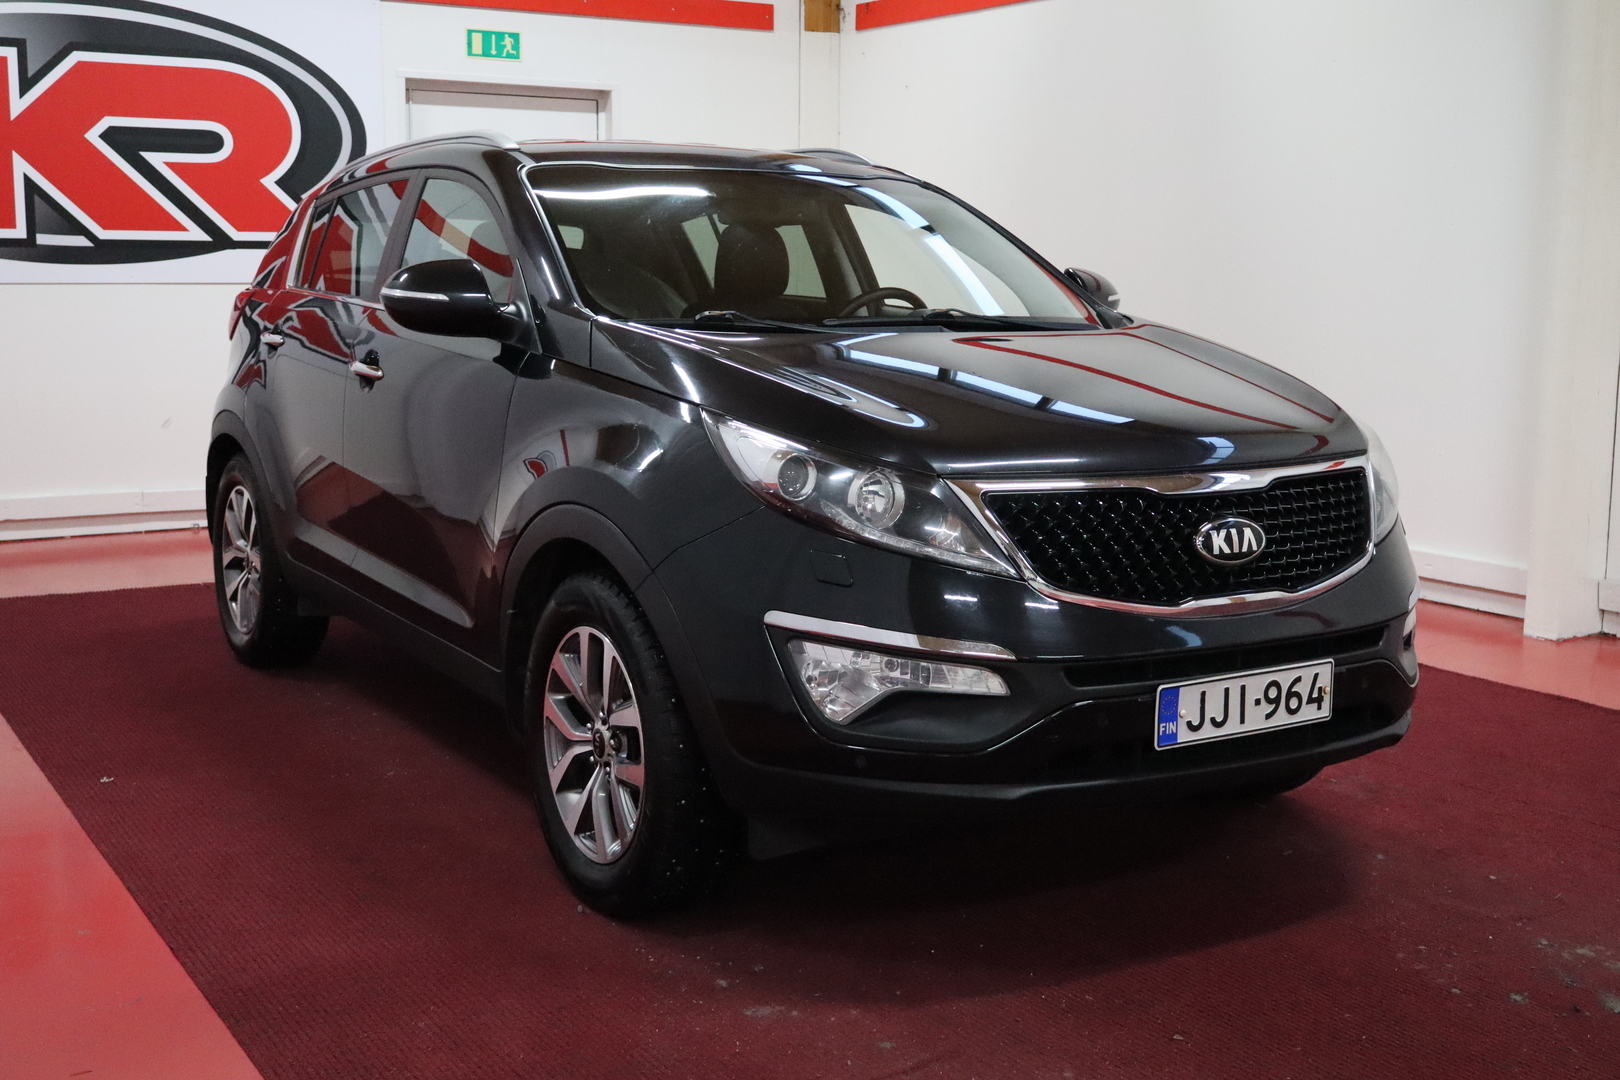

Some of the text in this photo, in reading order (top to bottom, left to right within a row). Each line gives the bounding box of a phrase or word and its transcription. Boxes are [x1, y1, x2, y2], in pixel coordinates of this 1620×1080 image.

[1209, 527, 1258, 555] KIA
[1159, 672, 1325, 736] FIN JJI-964
